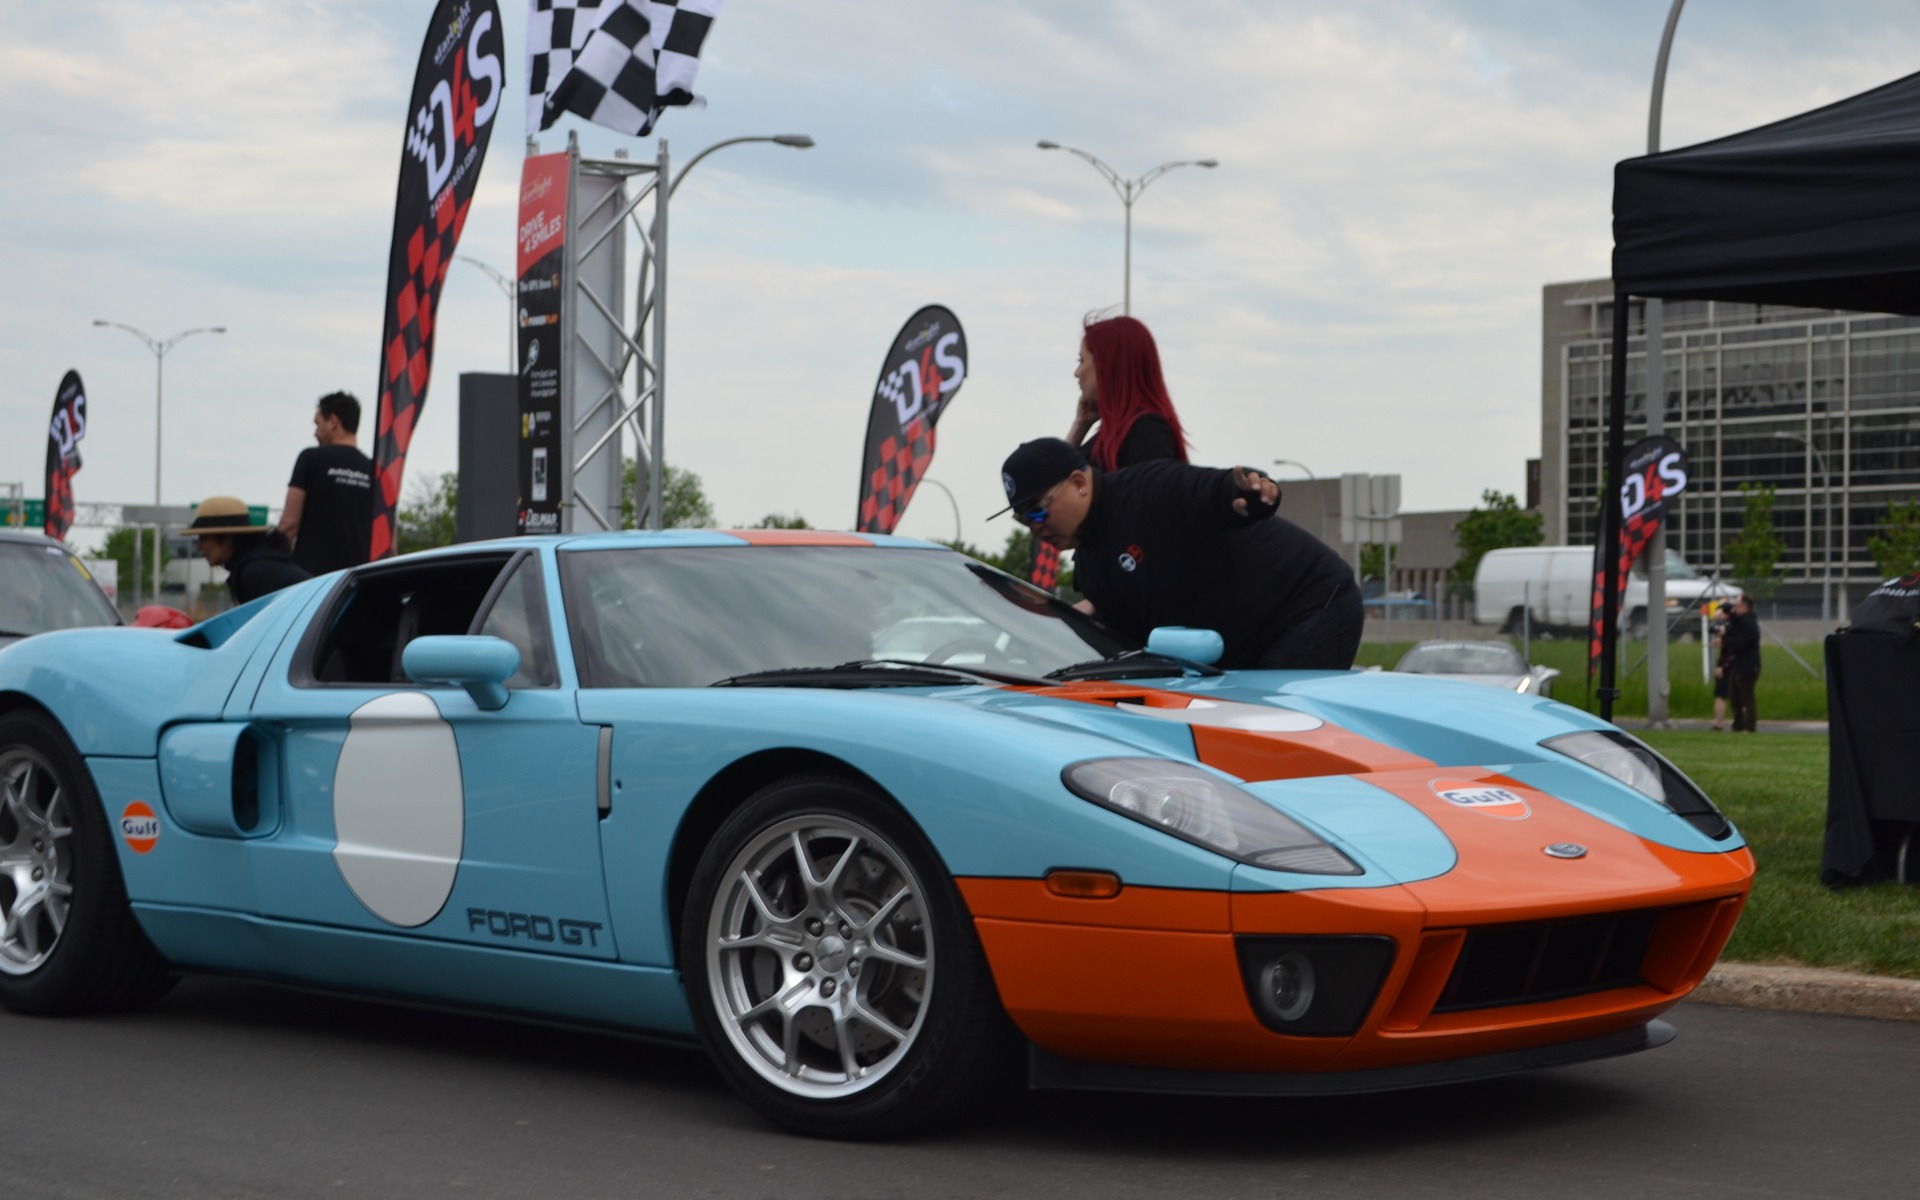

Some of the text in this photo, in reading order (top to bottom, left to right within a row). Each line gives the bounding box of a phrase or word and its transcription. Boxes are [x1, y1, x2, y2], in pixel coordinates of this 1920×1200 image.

[408, 10, 501, 200] D4S
[520, 210, 545, 243] DRIVE
[531, 214, 562, 250] SMILES
[878, 332, 965, 424] D4S
[1621, 452, 1687, 519] D4S
[1444, 789, 1517, 804] Gulf
[122, 819, 158, 836] Gulf
[467, 907, 603, 947] FORD GT
